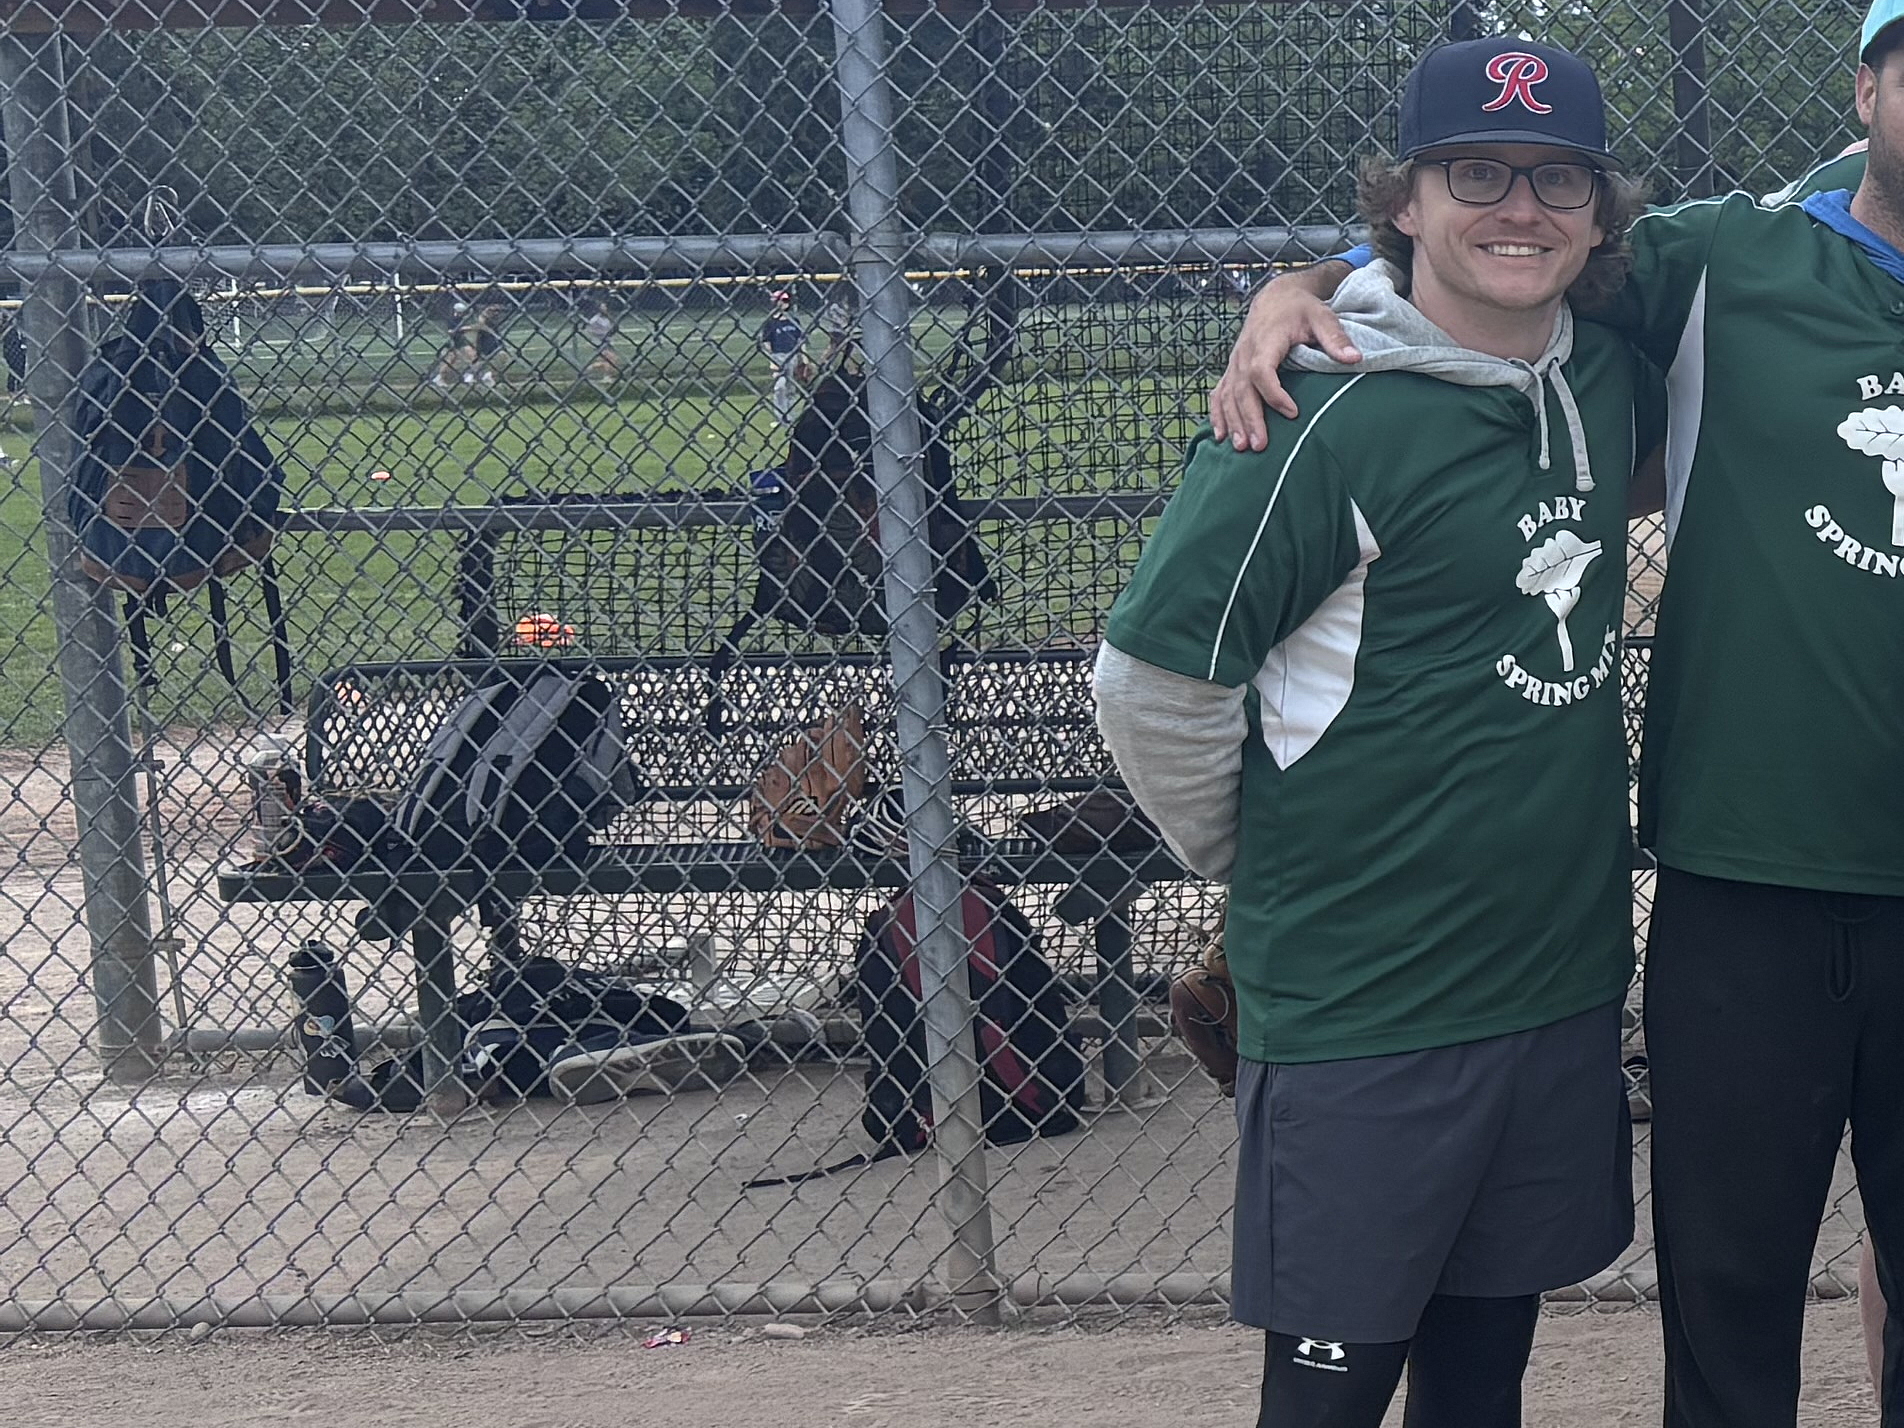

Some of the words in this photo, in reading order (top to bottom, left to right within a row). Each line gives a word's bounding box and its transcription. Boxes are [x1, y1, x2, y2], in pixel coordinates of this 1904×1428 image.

[1482, 51, 1553, 115] R
[1517, 496, 1587, 541] BABY
[1496, 655, 1590, 706] SPRING
